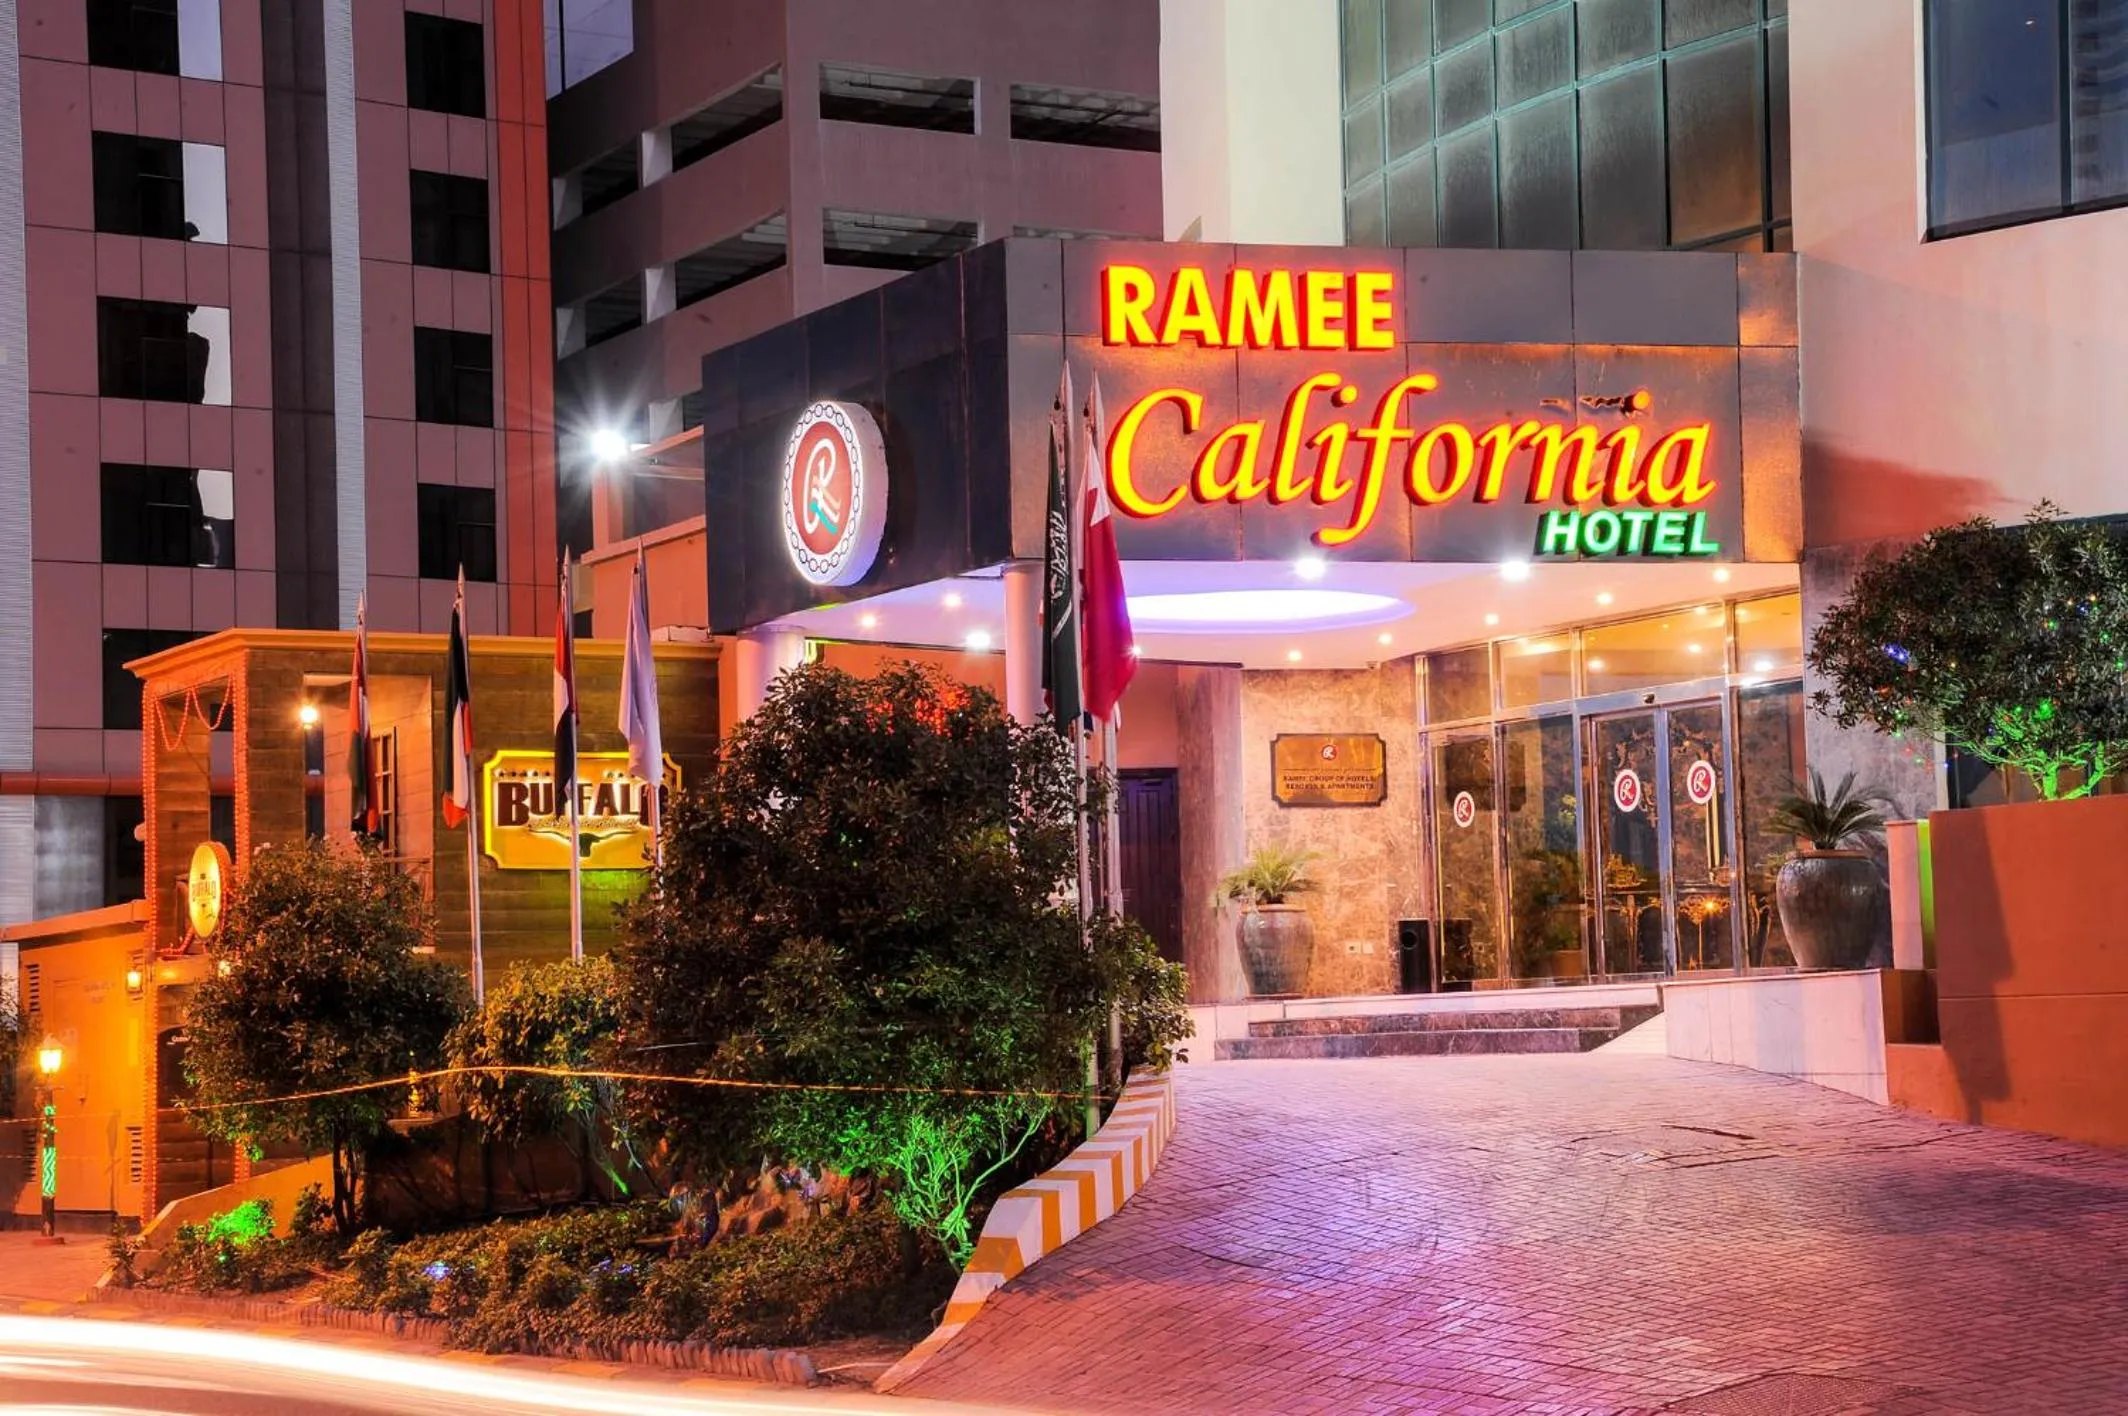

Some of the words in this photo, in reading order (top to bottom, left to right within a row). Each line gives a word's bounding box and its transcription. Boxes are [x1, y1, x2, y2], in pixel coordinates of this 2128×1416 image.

[1102, 265, 1396, 350] RAMEE
[1106, 372, 1716, 547] California
[1535, 509, 1721, 556] HOTEL
[497, 781, 669, 827] BUFALO
